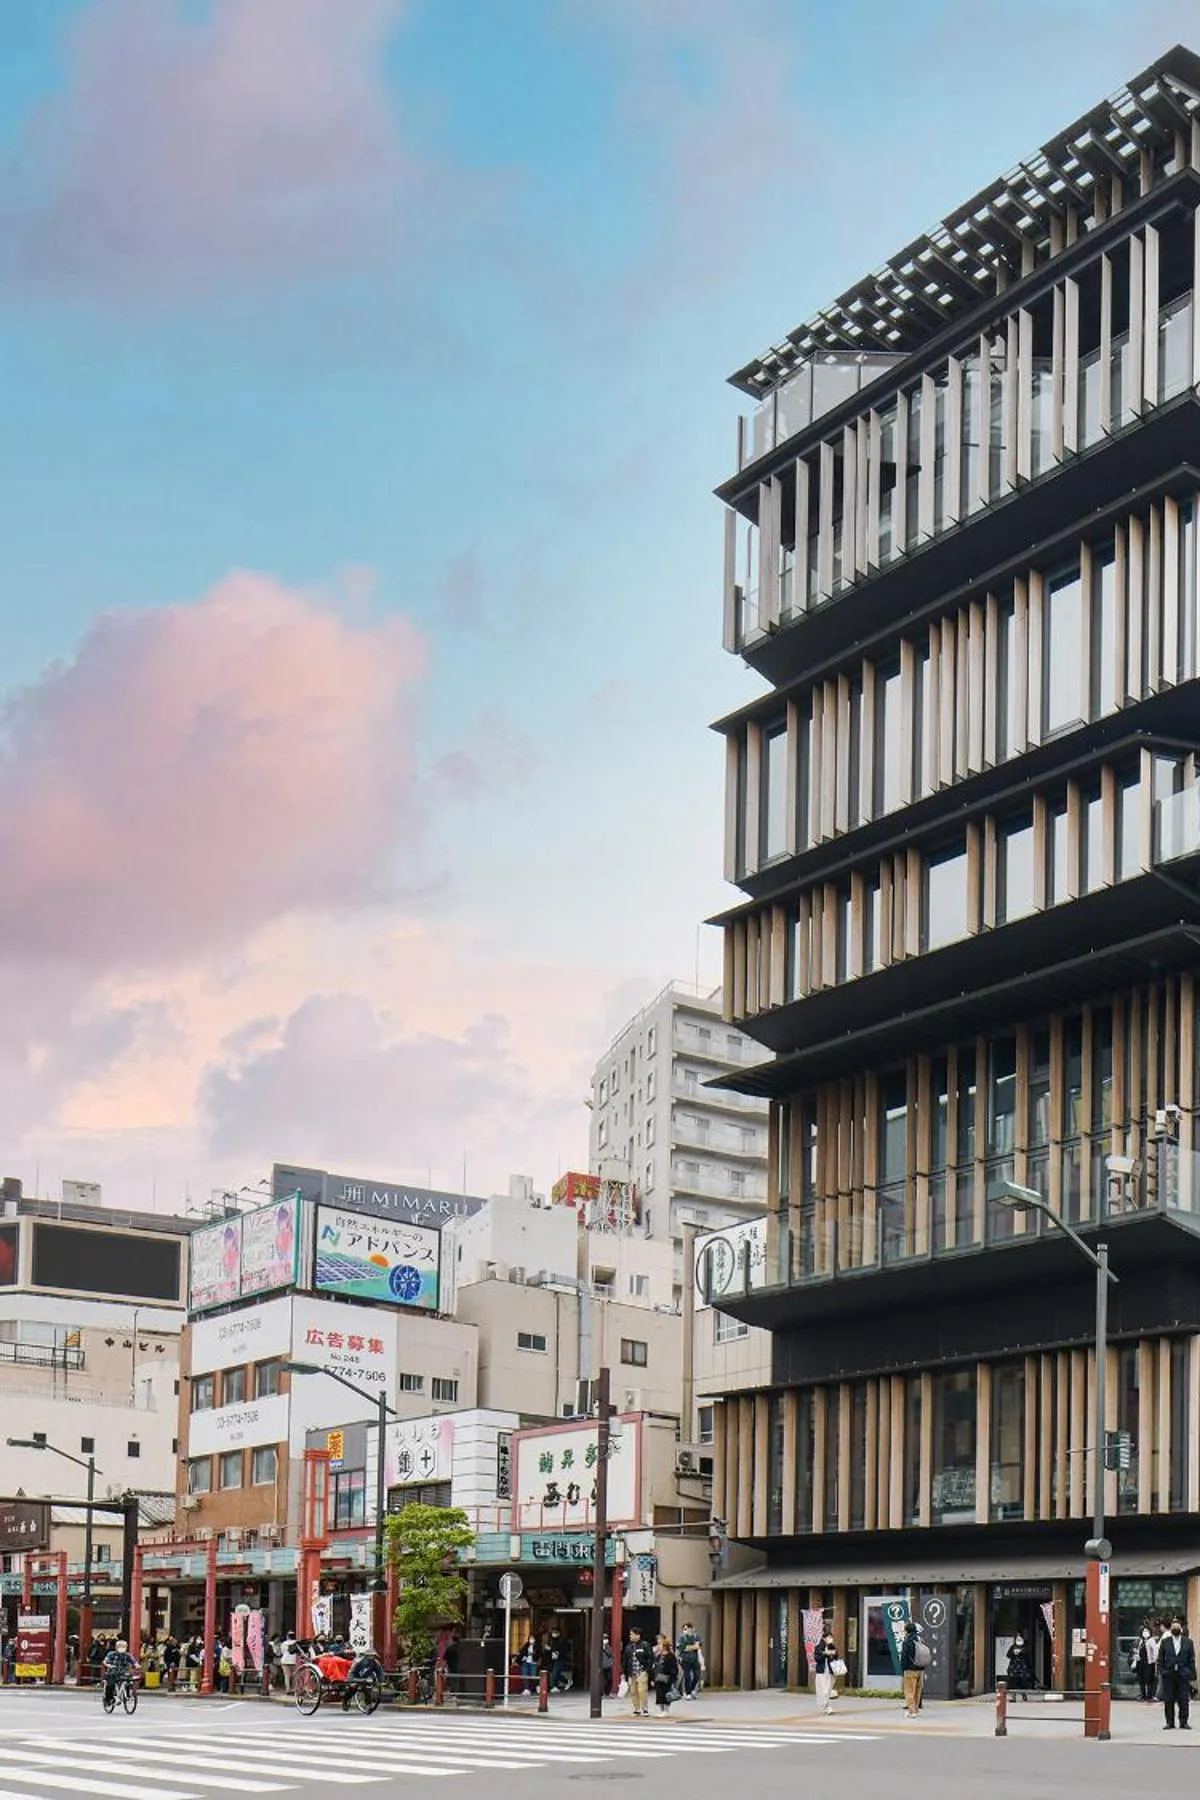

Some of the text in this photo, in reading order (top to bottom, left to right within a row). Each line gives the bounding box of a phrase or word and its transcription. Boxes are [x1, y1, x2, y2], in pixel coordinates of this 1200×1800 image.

[371, 1191, 468, 1217] MIMARU
[346, 1232, 435, 1263] アドバンス
[104, 1337, 166, 1353] 中山ビル
[305, 1328, 386, 1354] 広告募集
